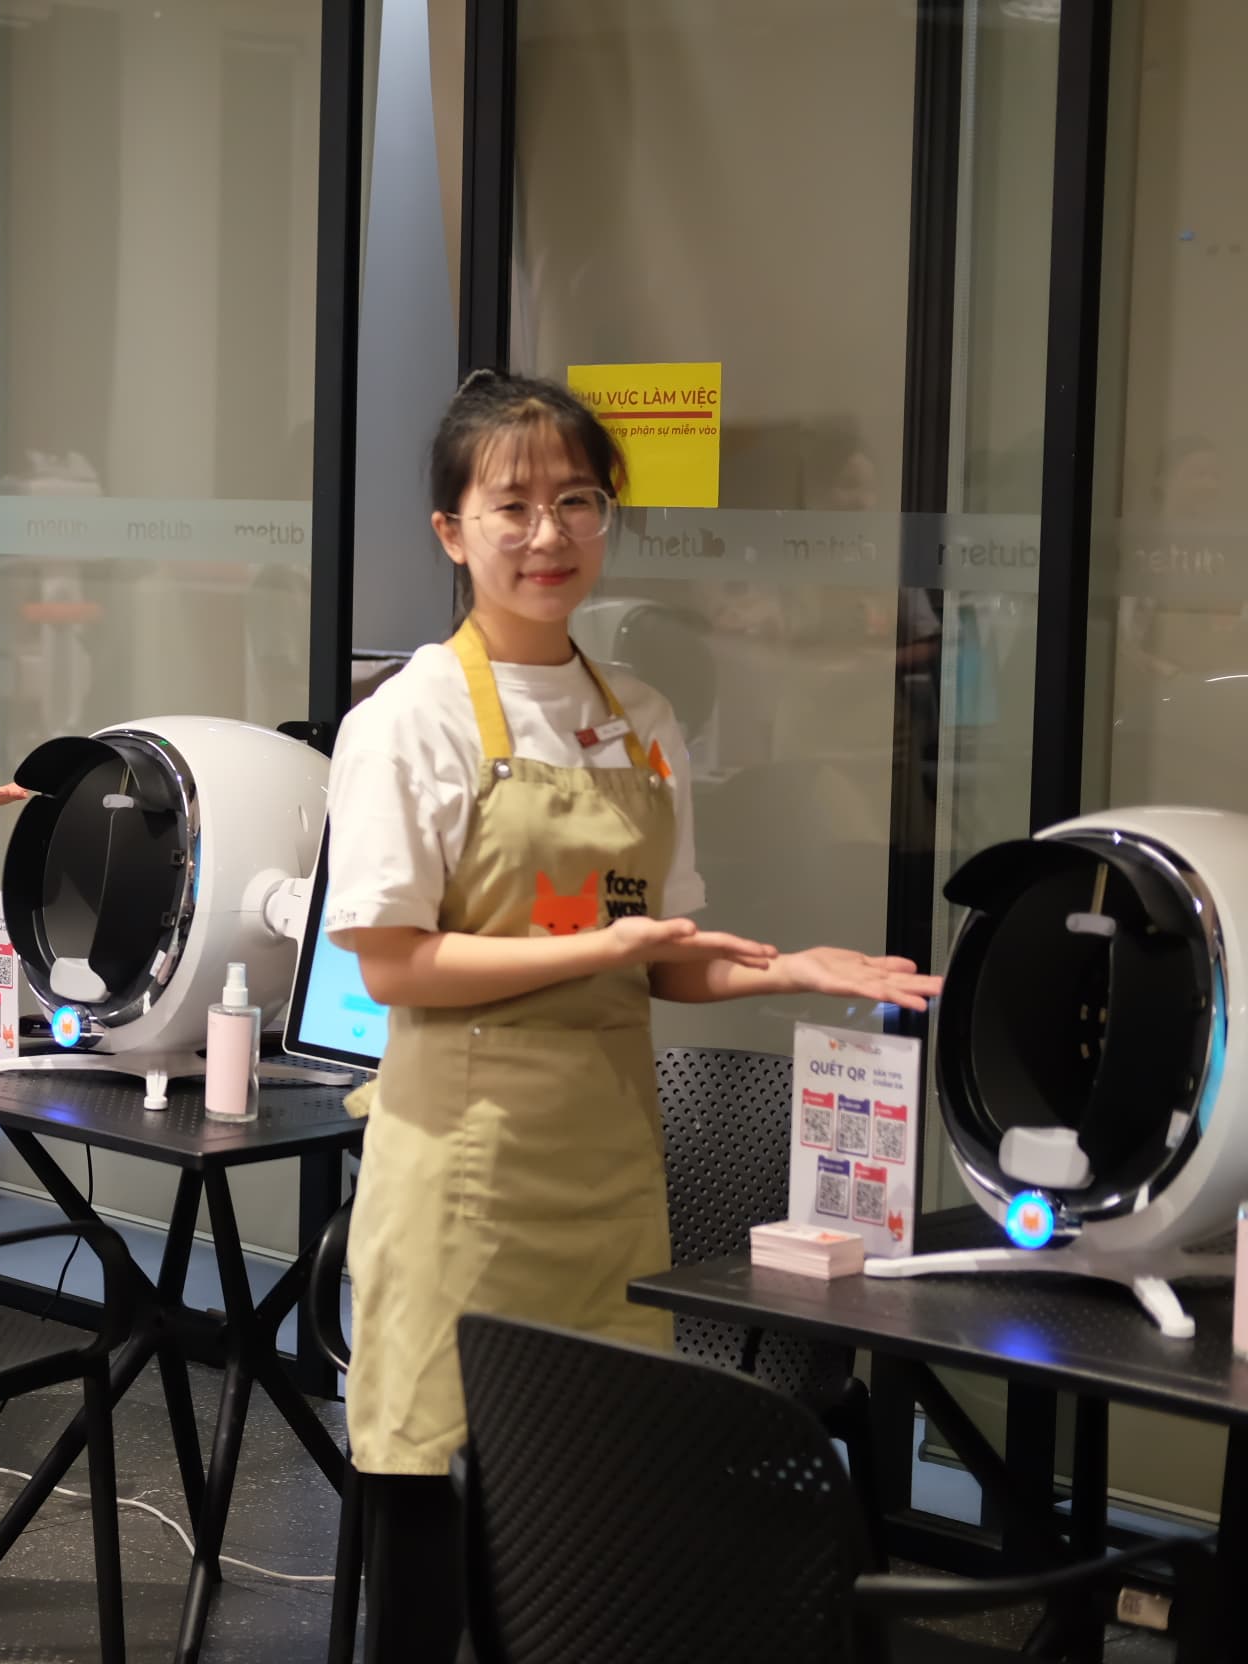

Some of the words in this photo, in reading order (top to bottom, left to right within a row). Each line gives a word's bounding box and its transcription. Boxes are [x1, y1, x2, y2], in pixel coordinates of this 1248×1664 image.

[574, 391, 602, 407] HU
[606, 388, 639, 409] VỰC
[643, 387, 676, 405] LÀM
[681, 386, 718, 409] VIỆC
[605, 868, 648, 897] face
[847, 1066, 866, 1082] QR
